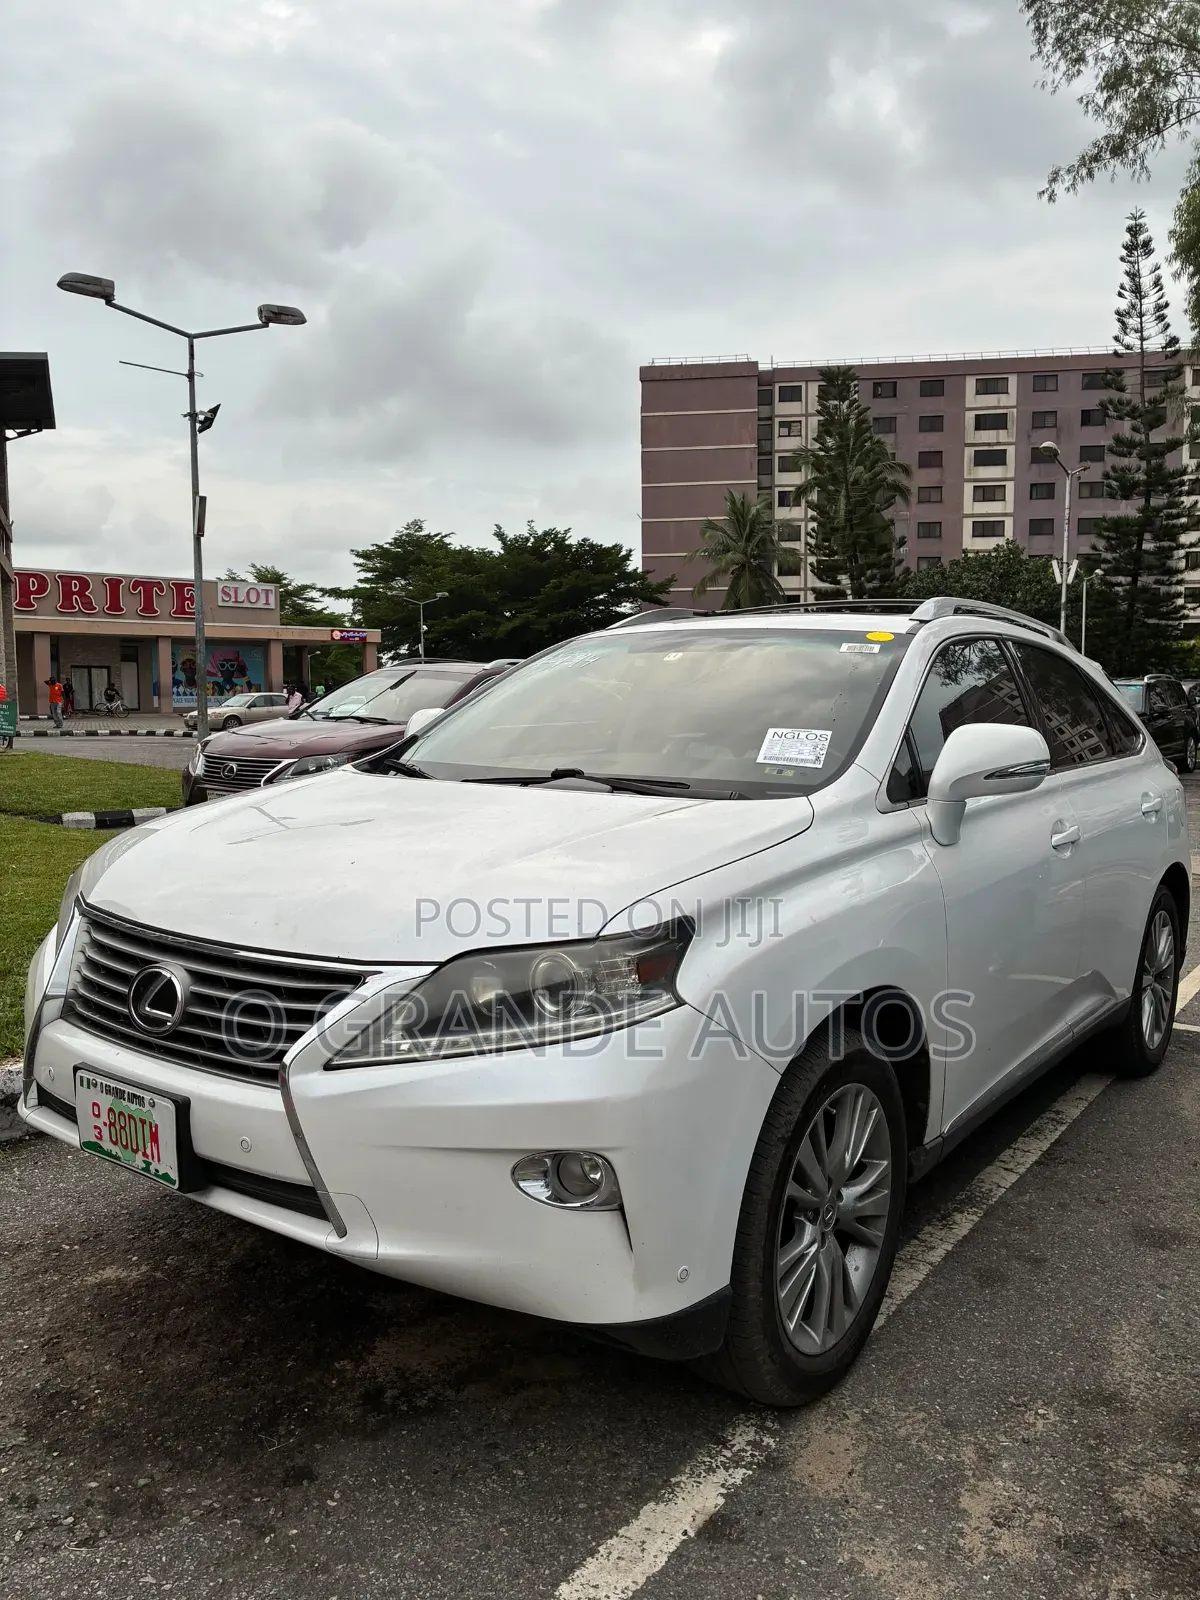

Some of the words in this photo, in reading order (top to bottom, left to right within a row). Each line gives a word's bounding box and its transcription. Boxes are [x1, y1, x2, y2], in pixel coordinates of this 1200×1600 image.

[13, 570, 197, 618] PRITE
[221, 585, 273, 606] SLOT
[772, 731, 829, 742] NGLOS
[104, 1084, 126, 1101] GRANDE
[127, 1091, 145, 1108] AUTOS
